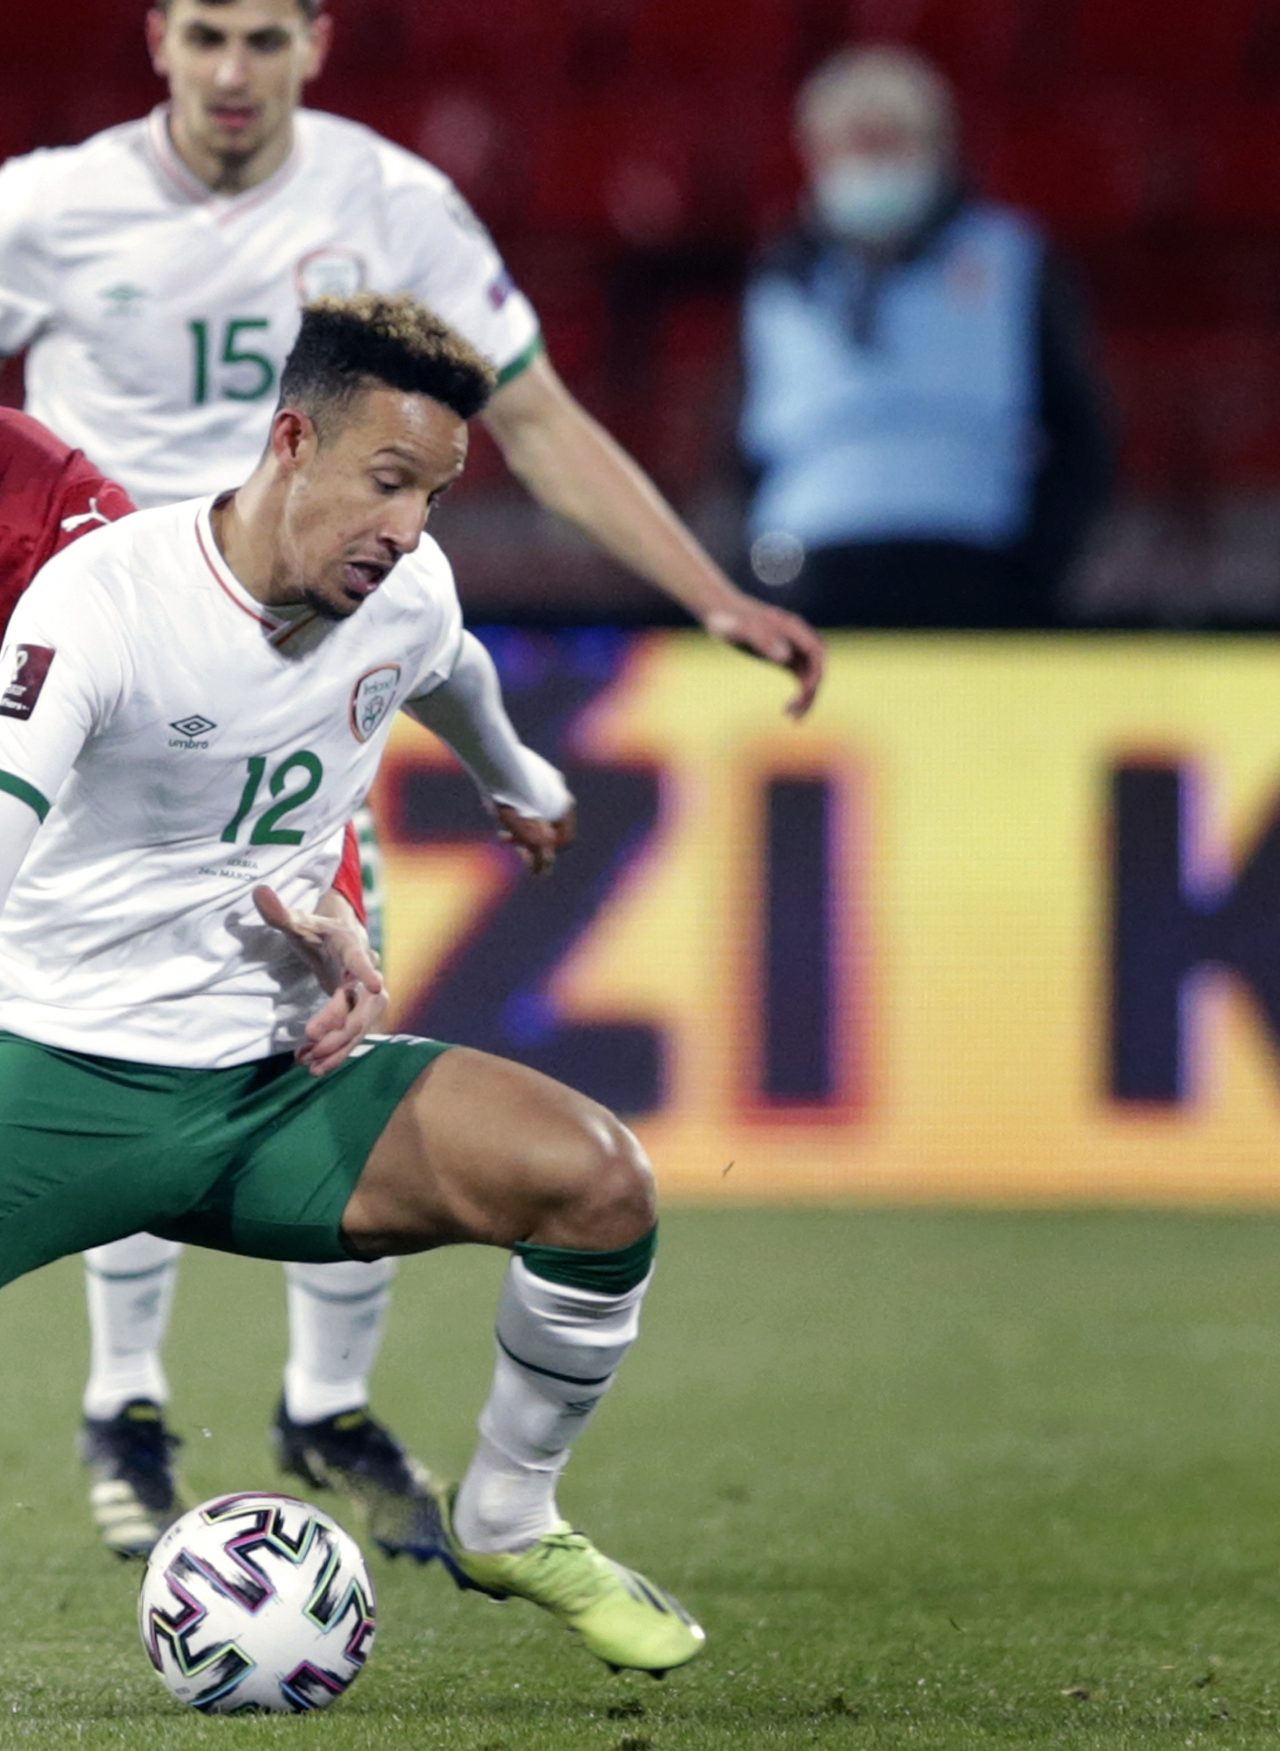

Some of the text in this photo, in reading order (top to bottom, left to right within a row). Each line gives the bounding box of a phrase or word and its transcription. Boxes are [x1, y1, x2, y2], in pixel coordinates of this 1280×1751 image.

[186, 317, 277, 404] 15
[168, 736, 210, 751] umbro
[220, 749, 324, 846] 12
